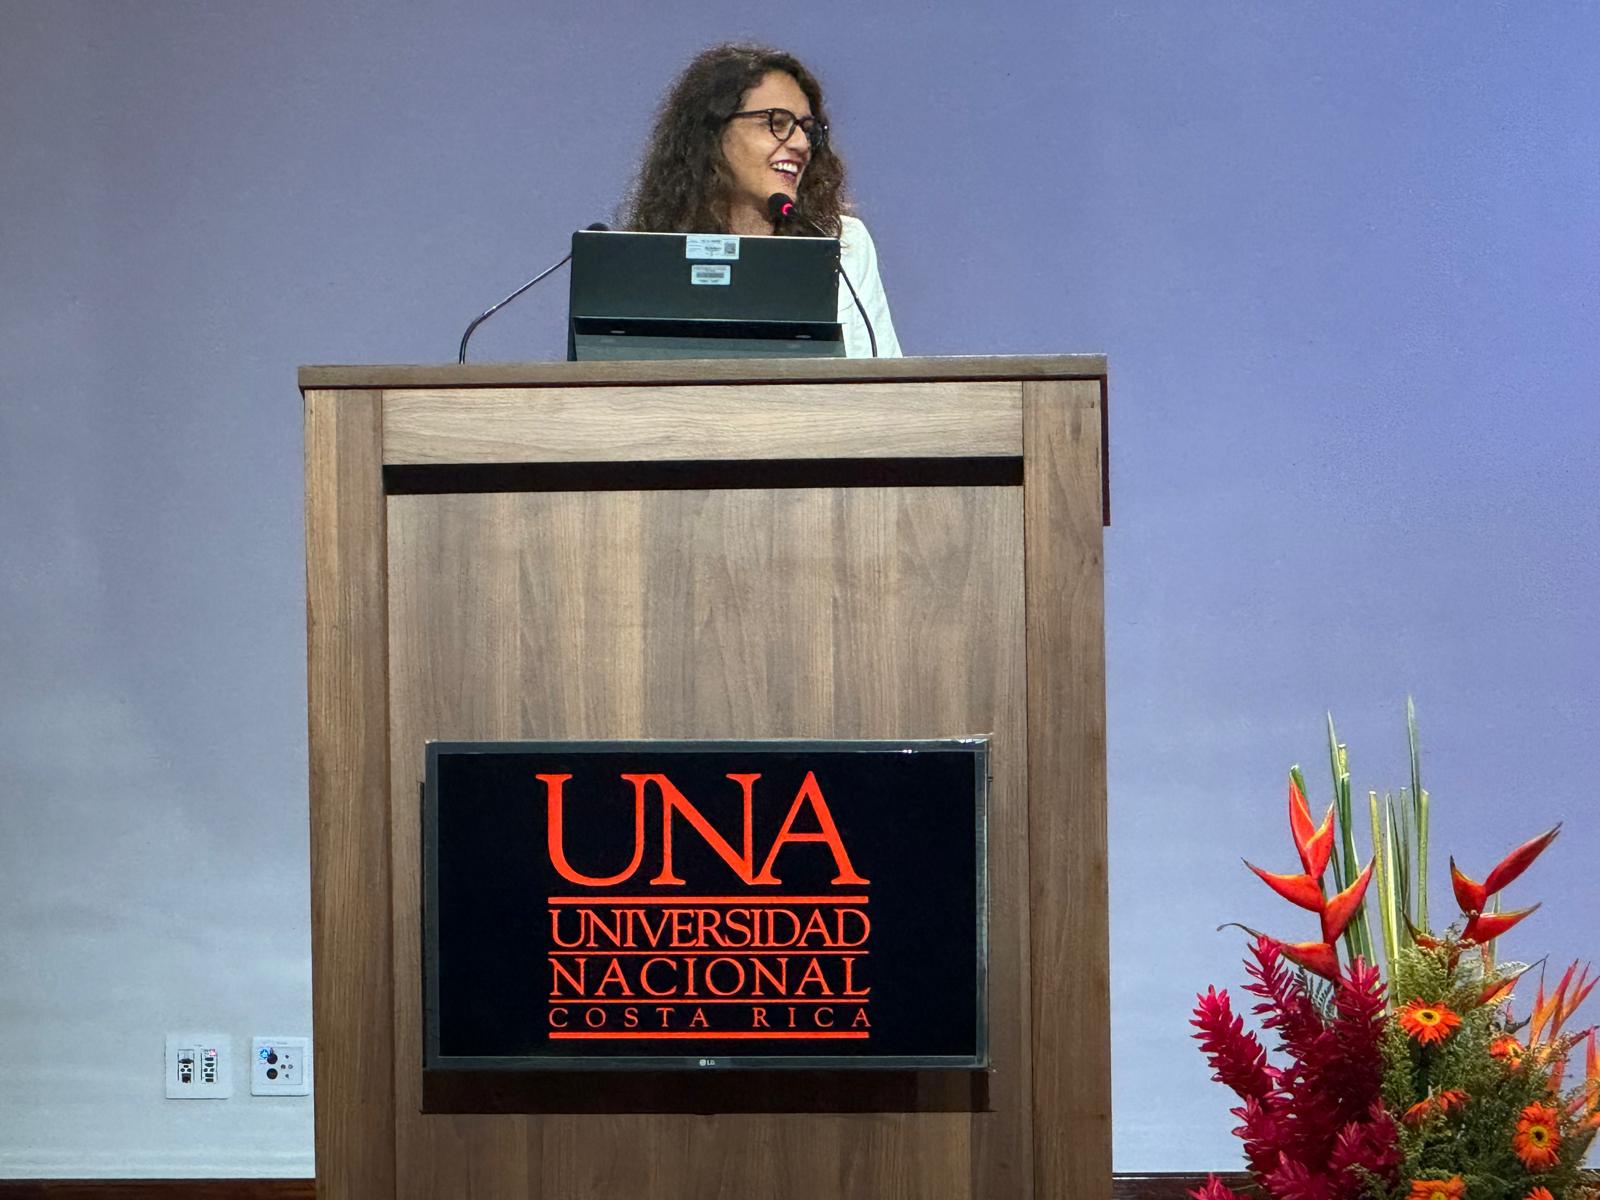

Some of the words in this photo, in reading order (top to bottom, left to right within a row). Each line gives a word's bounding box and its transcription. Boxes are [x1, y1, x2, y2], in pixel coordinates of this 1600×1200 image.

[535, 770, 871, 887] UNA
[548, 908, 871, 948] UNIVERSIDAD
[548, 957, 871, 997] NACIONAL
[548, 1007, 710, 1028] COSTA
[752, 1007, 871, 1028] RICA
